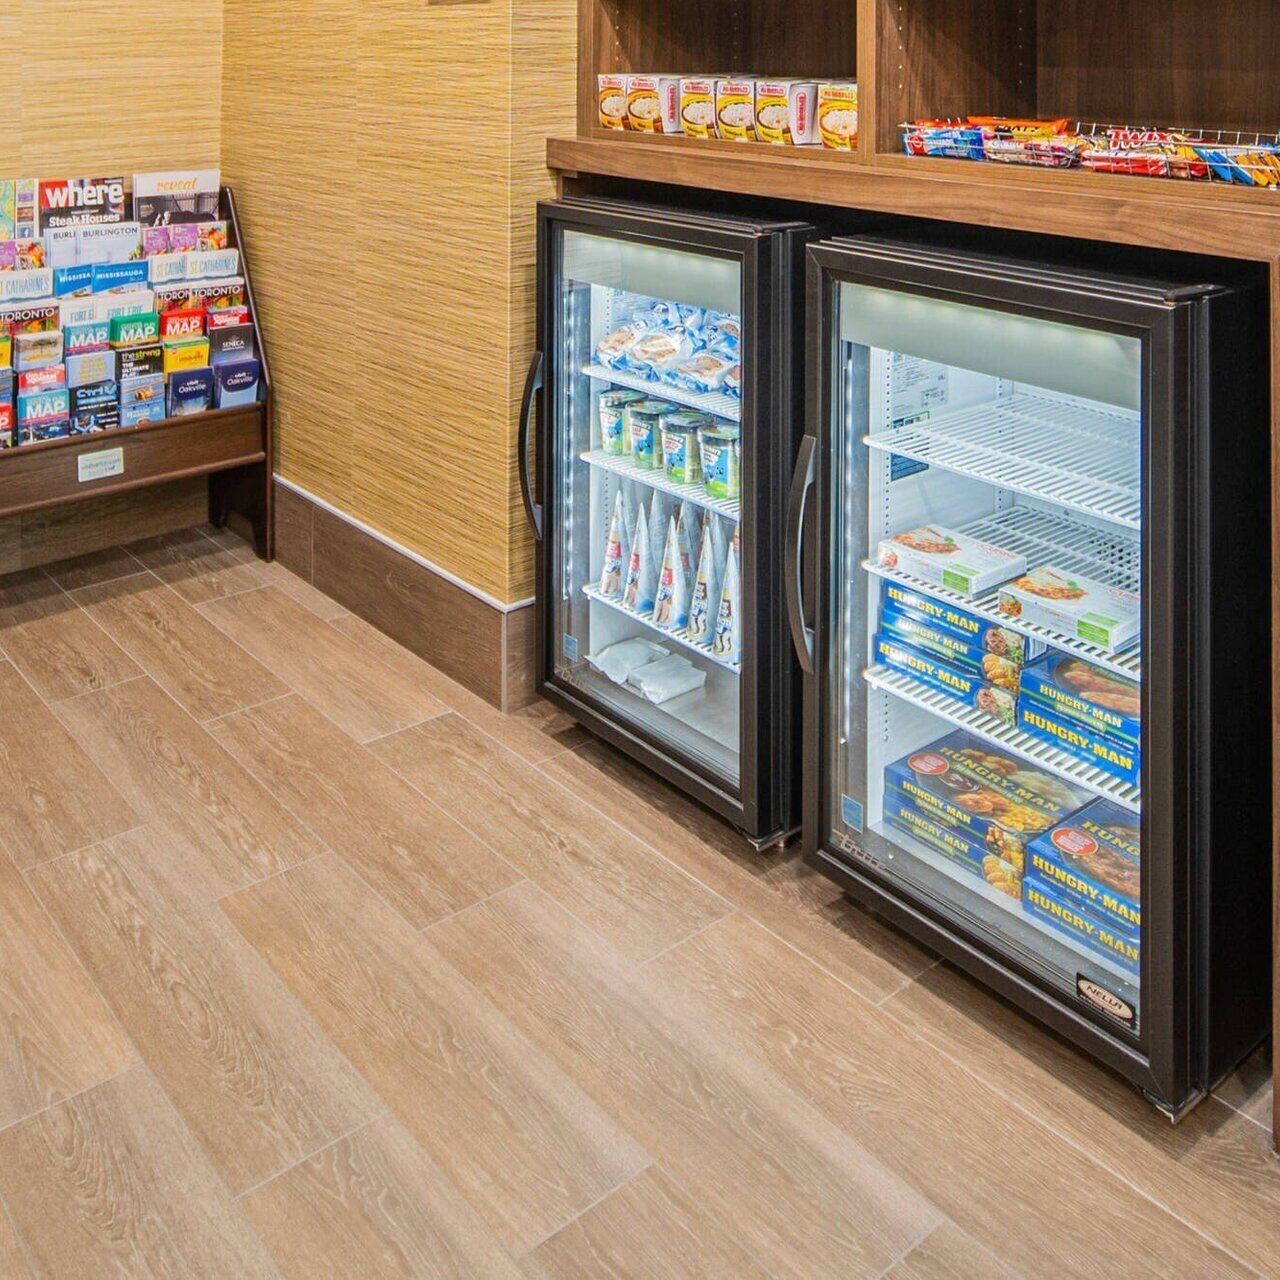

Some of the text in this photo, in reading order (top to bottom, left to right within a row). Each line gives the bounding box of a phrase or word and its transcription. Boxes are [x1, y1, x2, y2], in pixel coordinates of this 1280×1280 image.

[156, 177, 198, 192] reveal
[45, 179, 125, 208] where
[49, 212, 120, 228] Steak Houses
[82, 227, 139, 239] BURLINGTON
[96, 269, 145, 280] MISSISSAUGA
[6, 277, 51, 296] CATHARINES
[192, 285, 242, 298] TORONTO
[0, 308, 55, 323] TORONTO
[119, 326, 156, 342] MAP
[166, 321, 200, 337] MAP
[70, 331, 108, 348] MAP
[222, 340, 246, 348] SENECA
[122, 364, 150, 374] ULTIMATE
[178, 382, 207, 394] Oakville
[226, 375, 254, 387] Oakville
[26, 400, 66, 419] MAP
